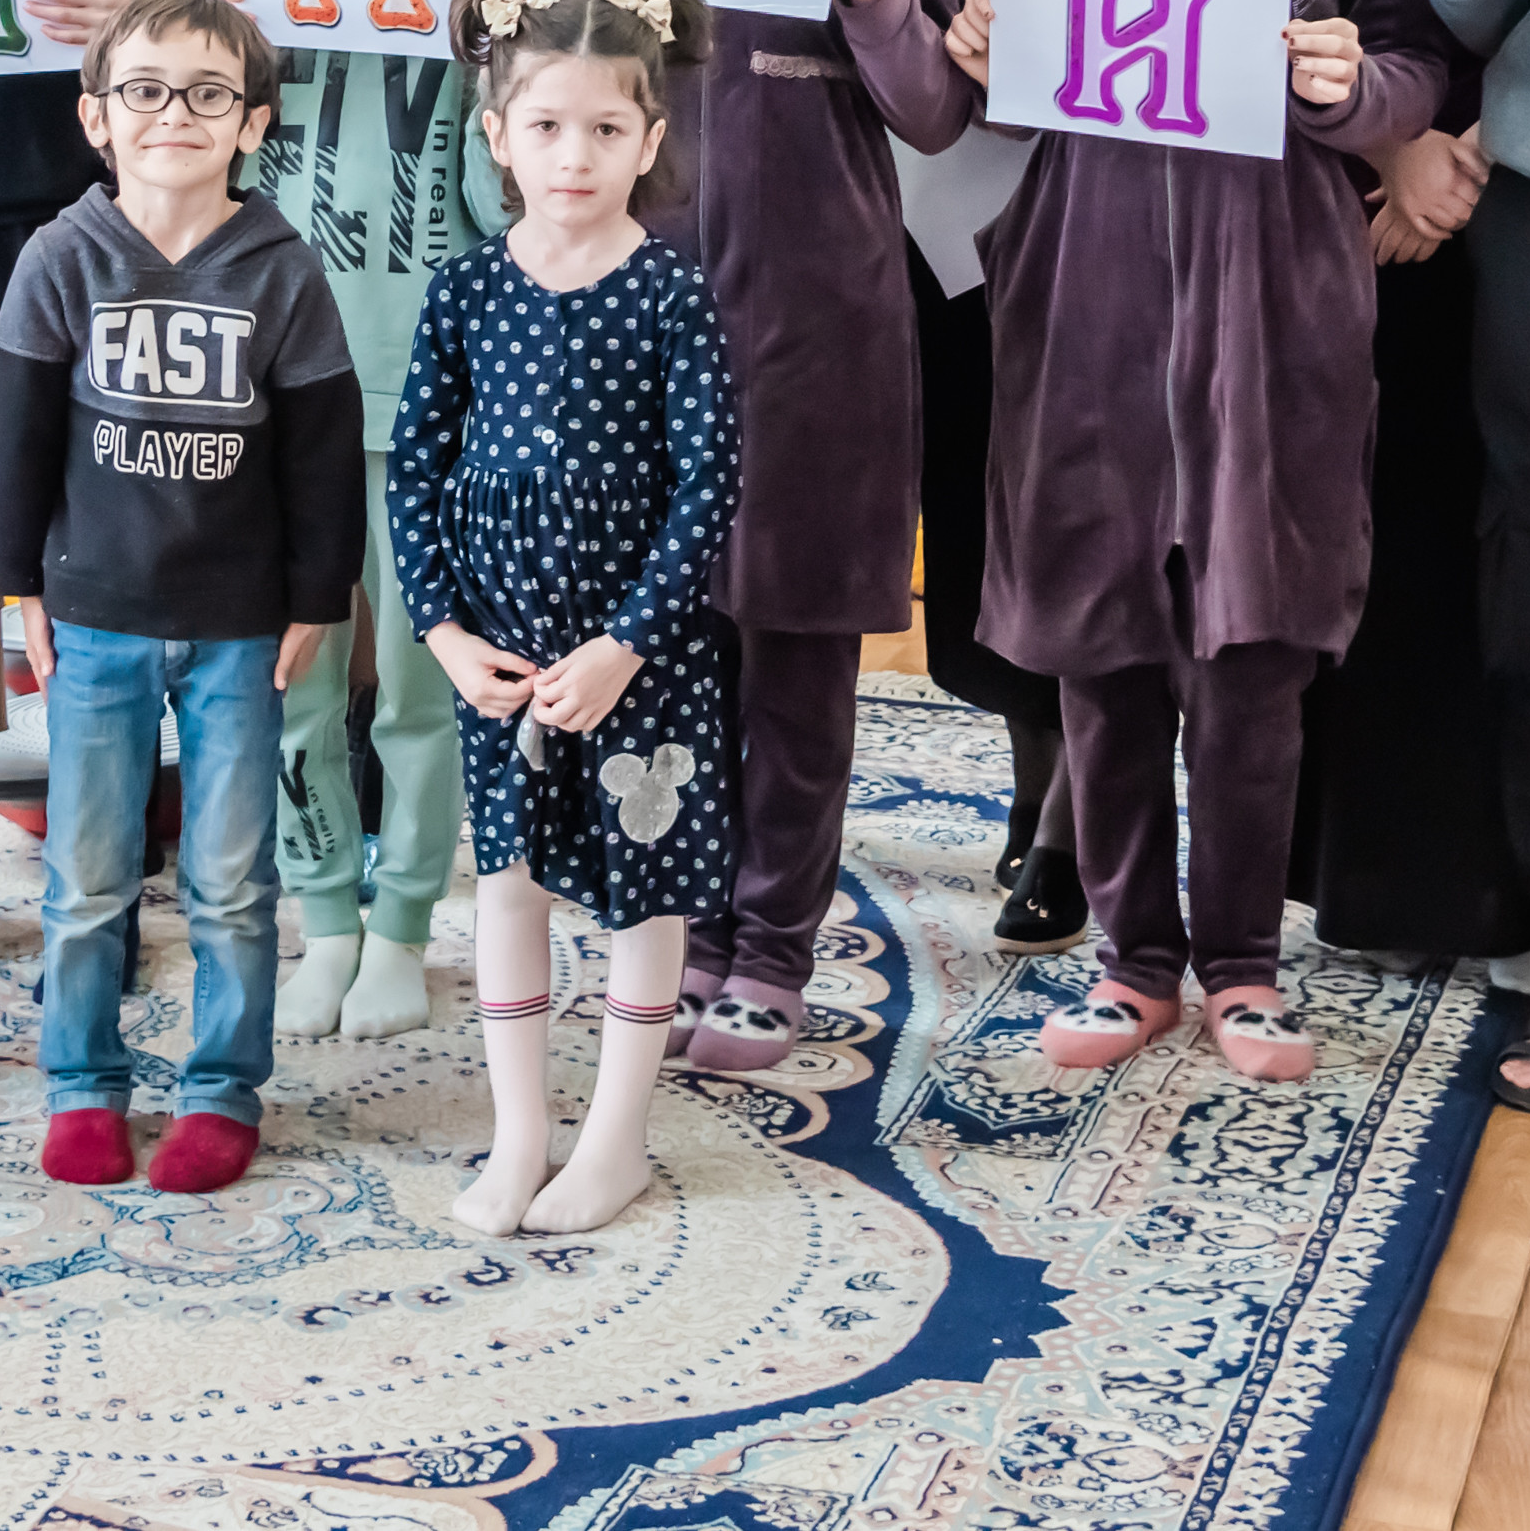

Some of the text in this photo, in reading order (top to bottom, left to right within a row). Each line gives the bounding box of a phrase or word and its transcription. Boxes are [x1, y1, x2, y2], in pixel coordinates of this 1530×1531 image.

[422, 119, 454, 271] in really
[91, 308, 252, 399] FAST
[93, 419, 245, 481] PLAYER
